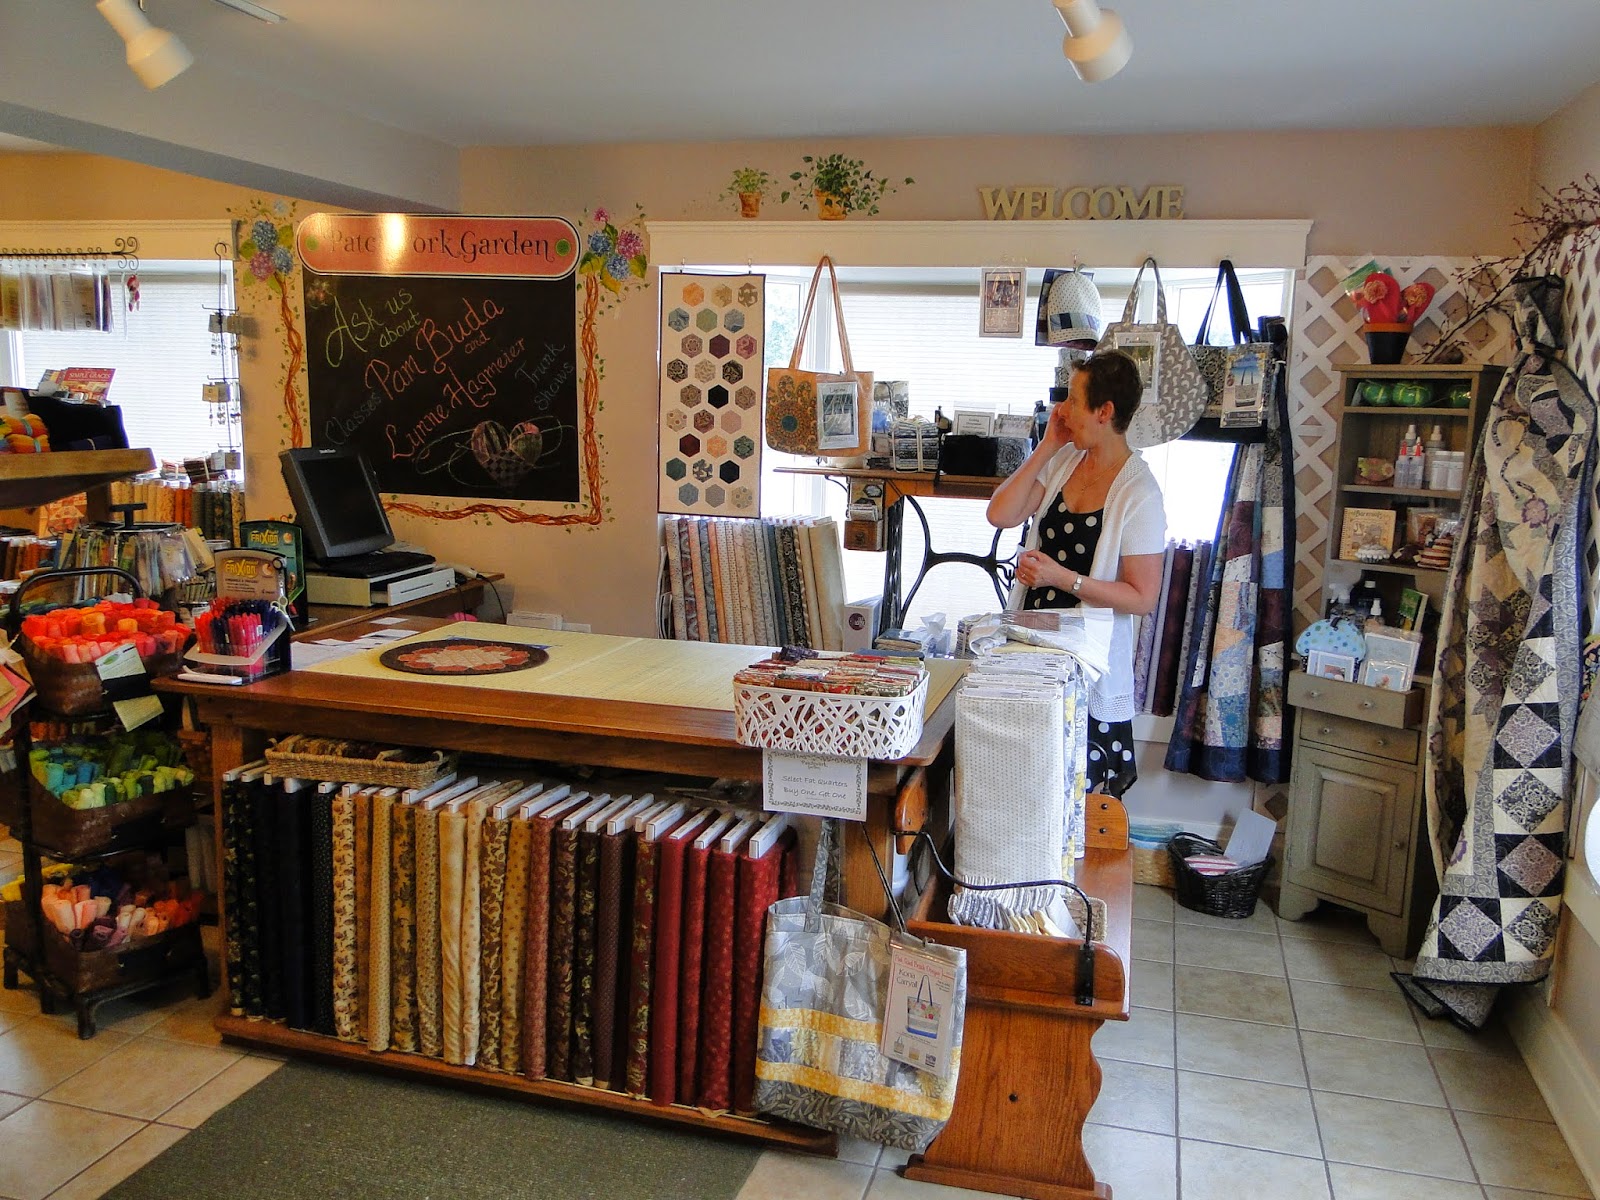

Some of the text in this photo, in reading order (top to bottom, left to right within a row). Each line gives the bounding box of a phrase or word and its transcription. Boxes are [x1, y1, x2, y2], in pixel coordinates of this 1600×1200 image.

[979, 185, 1184, 220] WELCOME
[325, 229, 556, 263] Patcork Garden
[326, 288, 413, 367] Ask us
[379, 310, 421, 348] about
[464, 332, 490, 354] and
[365, 298, 504, 400] Pam Buda
[515, 344, 566, 388] Trunk
[386, 338, 526, 461] Lynne Hagmeier
[325, 393, 382, 445] Classes
[783, 787, 799, 796] Buy
[818, 778, 848, 787] Quarters
[898, 968, 916, 979] Kona
